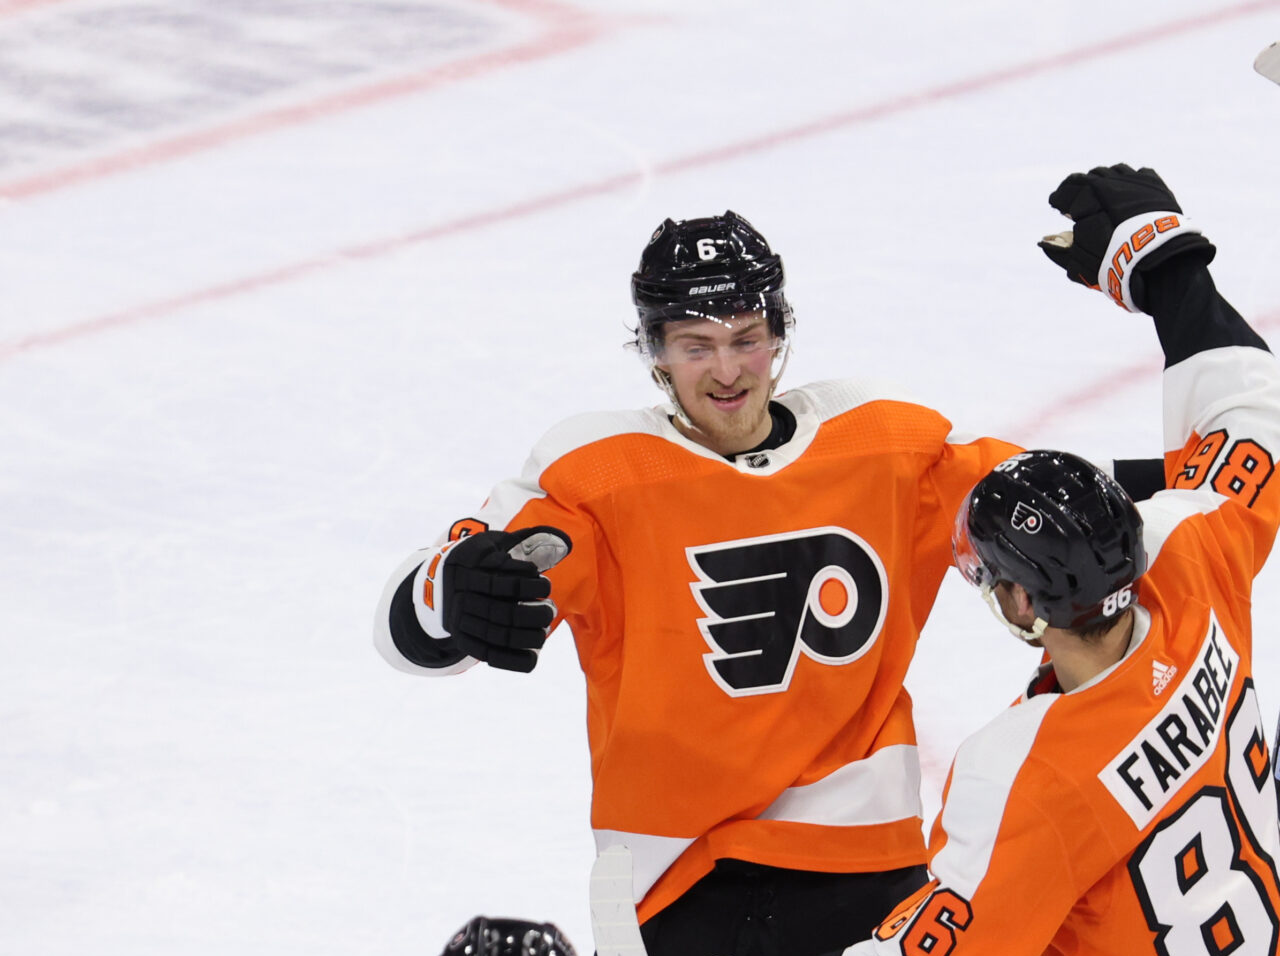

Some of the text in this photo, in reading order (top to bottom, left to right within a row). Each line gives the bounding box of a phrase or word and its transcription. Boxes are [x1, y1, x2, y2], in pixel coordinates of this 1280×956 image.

[697, 238, 717, 260] 6
[688, 282, 736, 295] BAUER
[1102, 583, 1133, 617] 86
[1116, 621, 1233, 811] FARABEE
